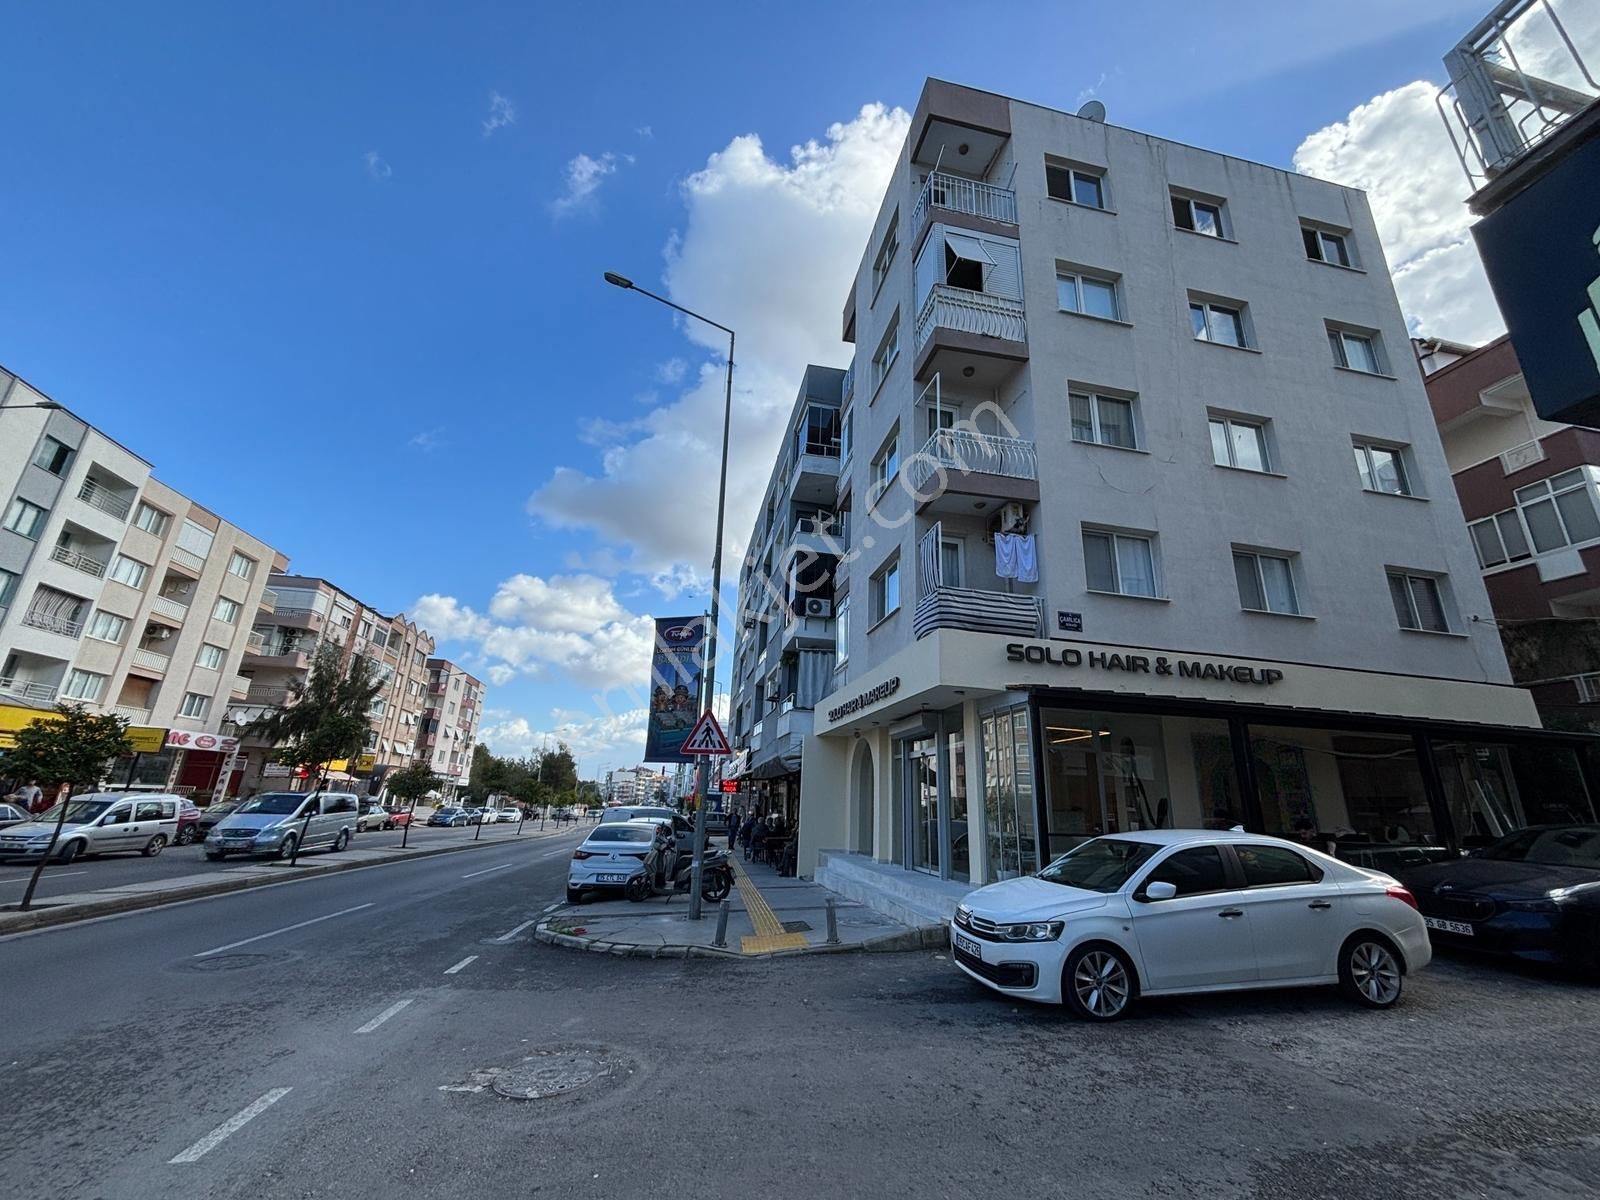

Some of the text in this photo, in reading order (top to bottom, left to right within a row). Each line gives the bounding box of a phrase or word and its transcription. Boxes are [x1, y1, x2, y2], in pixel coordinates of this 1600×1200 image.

[1006, 643, 1284, 685] SOLO HAIR & MAKEUP
[864, 676, 901, 706] MAKEUP
